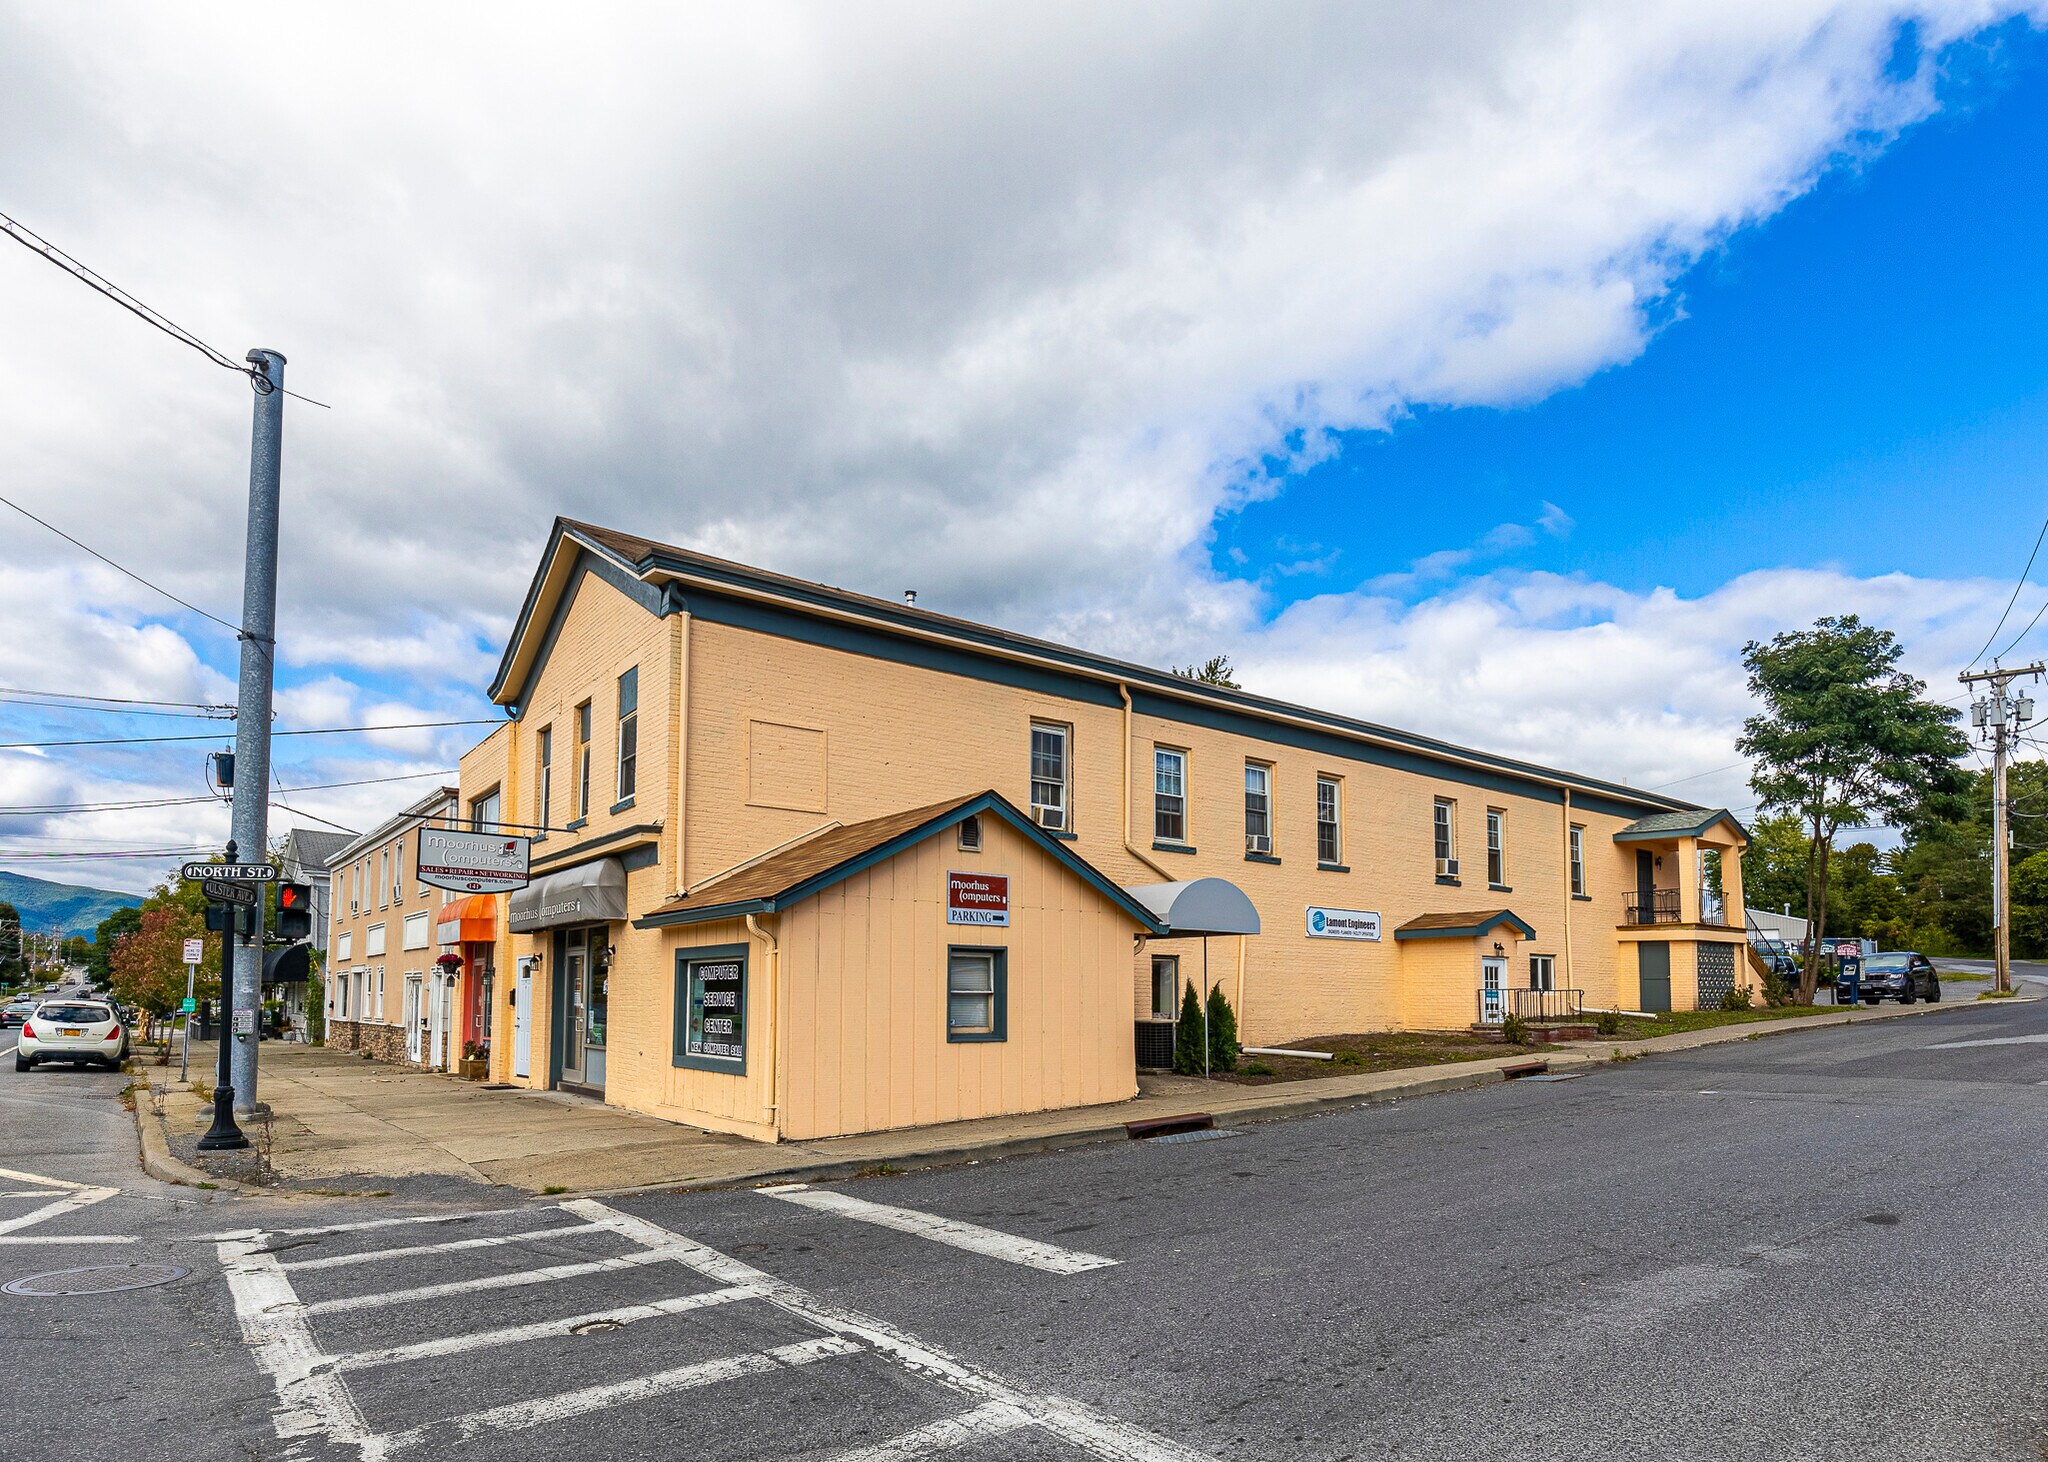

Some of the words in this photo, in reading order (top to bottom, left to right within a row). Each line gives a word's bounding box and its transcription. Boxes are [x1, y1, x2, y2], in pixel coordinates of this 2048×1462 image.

[442, 849, 512, 867] Computers
[193, 867, 241, 877] NORTH
[246, 867, 266, 878] ST.
[421, 866, 445, 874] SALES
[449, 868, 474, 877] REPAIR
[479, 871, 526, 880] NETWORKING
[435, 875, 514, 885] moorhuscomputers.com
[209, 882, 235, 899] ULSTER
[959, 889, 1001, 903] Computers
[952, 910, 991, 922] PARKING
[1326, 917, 1347, 928] Lamont
[1348, 918, 1376, 930] Engineers
[699, 965, 739, 980] COMPUTER
[703, 992, 735, 1007] SERVICE
[703, 1018, 733, 1034] CENTER
[691, 1041, 702, 1052] NEW
[703, 1042, 729, 1055] COMPUTER
